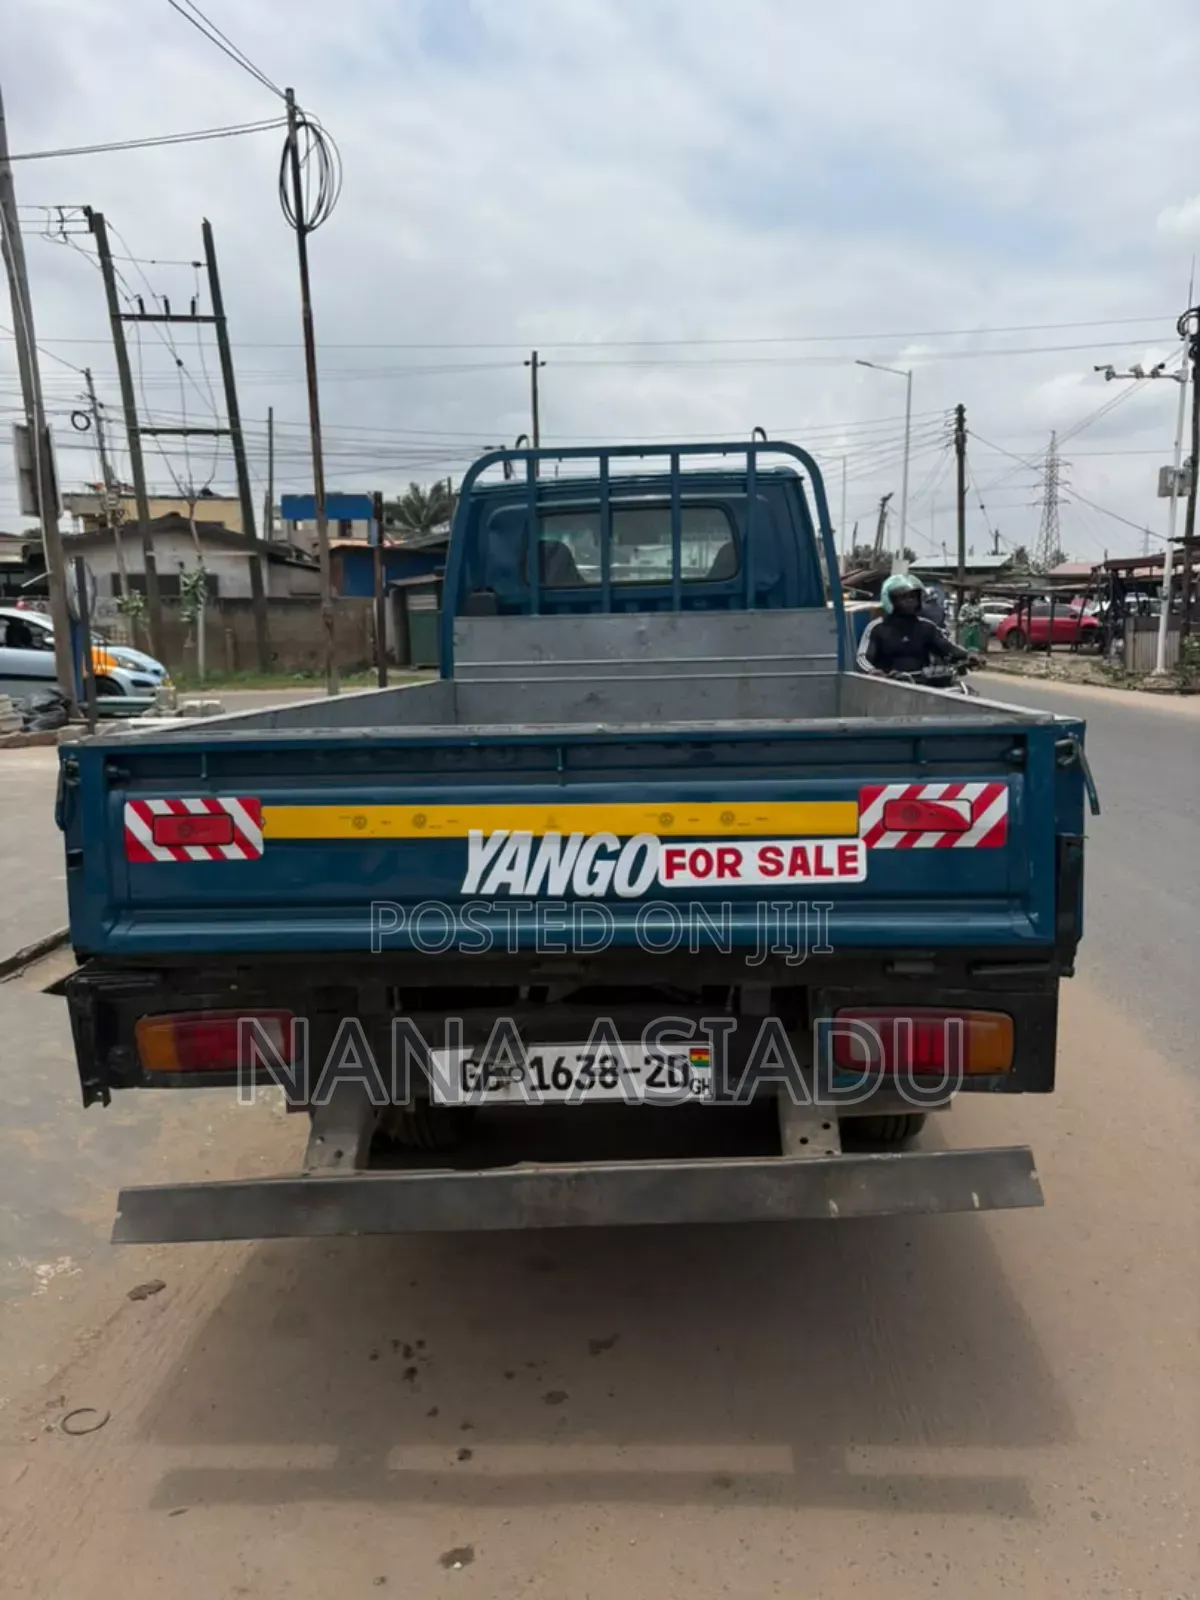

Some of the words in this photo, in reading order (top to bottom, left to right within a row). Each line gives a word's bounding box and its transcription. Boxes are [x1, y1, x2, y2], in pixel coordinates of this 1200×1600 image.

[460, 829, 660, 898] YANGO
[665, 848, 743, 879] FOR
[758, 845, 858, 877] SALE
